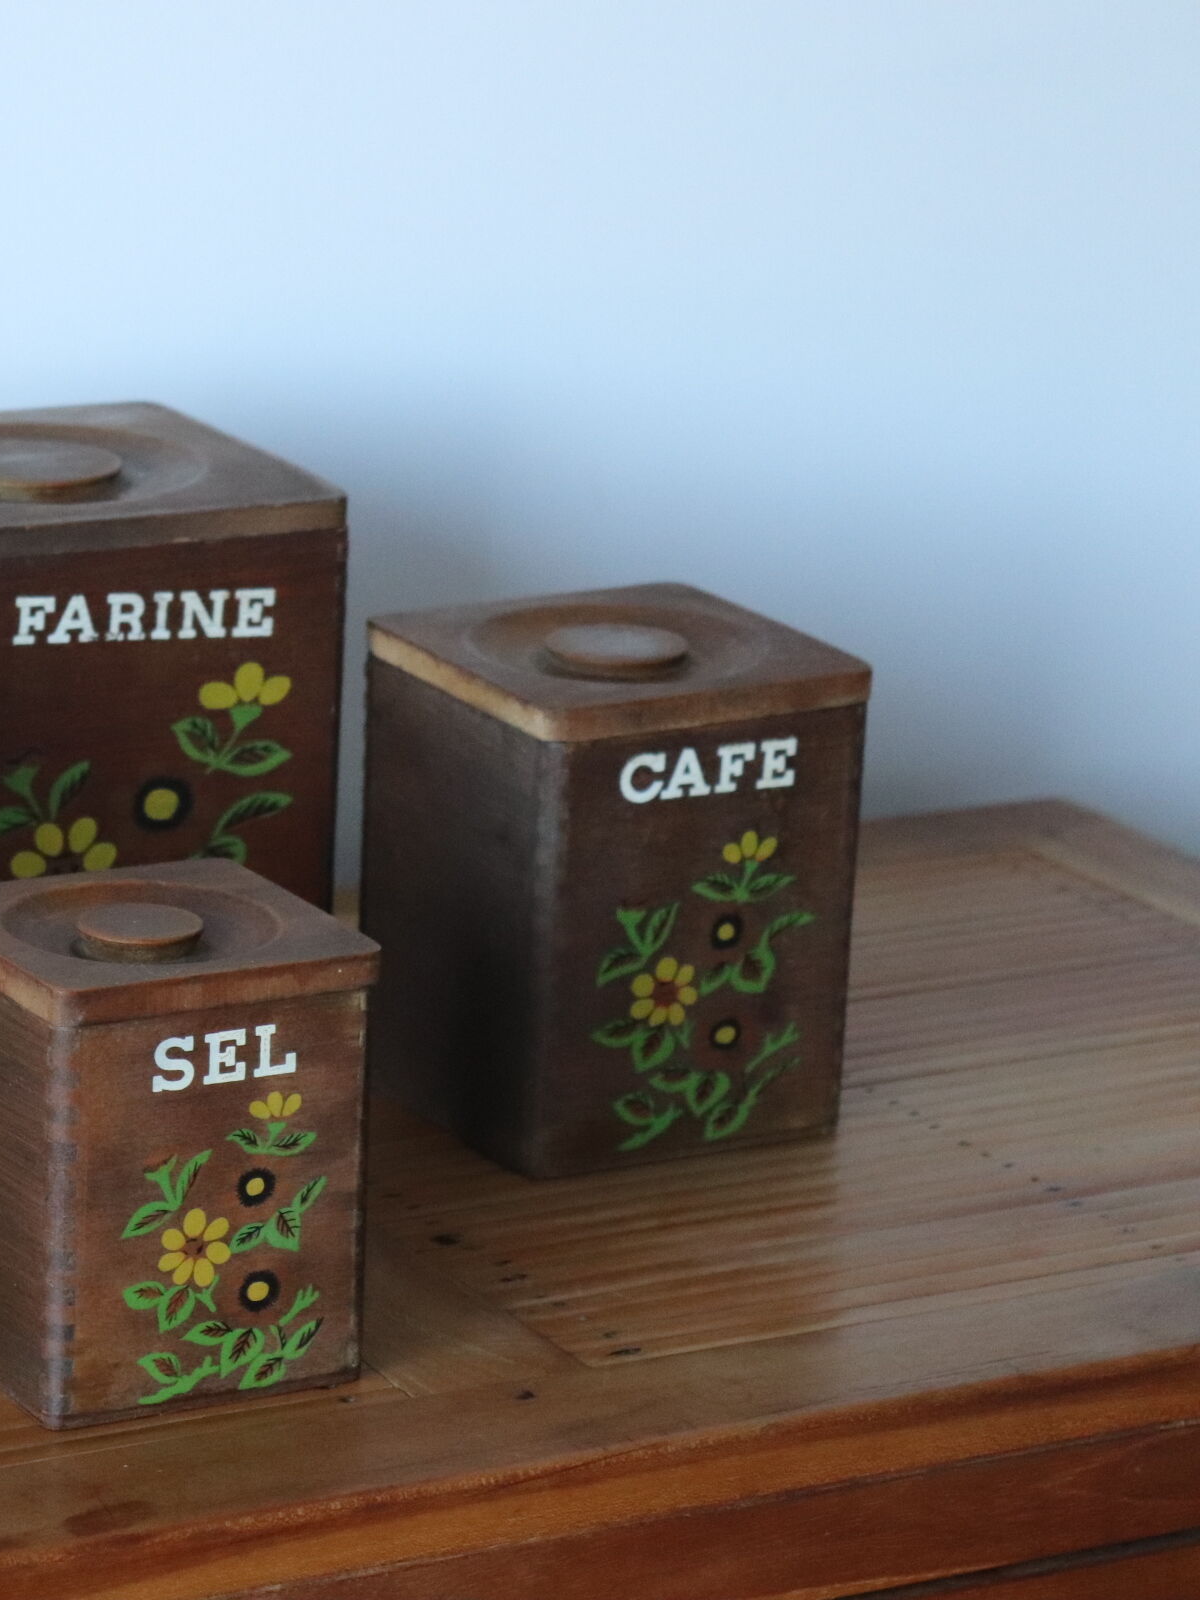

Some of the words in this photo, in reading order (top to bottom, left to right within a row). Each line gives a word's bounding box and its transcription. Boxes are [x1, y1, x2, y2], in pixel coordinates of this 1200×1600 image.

[12, 588, 276, 646] FARINE
[619, 737, 798, 804] CAFE
[151, 1023, 297, 1093] SEL
